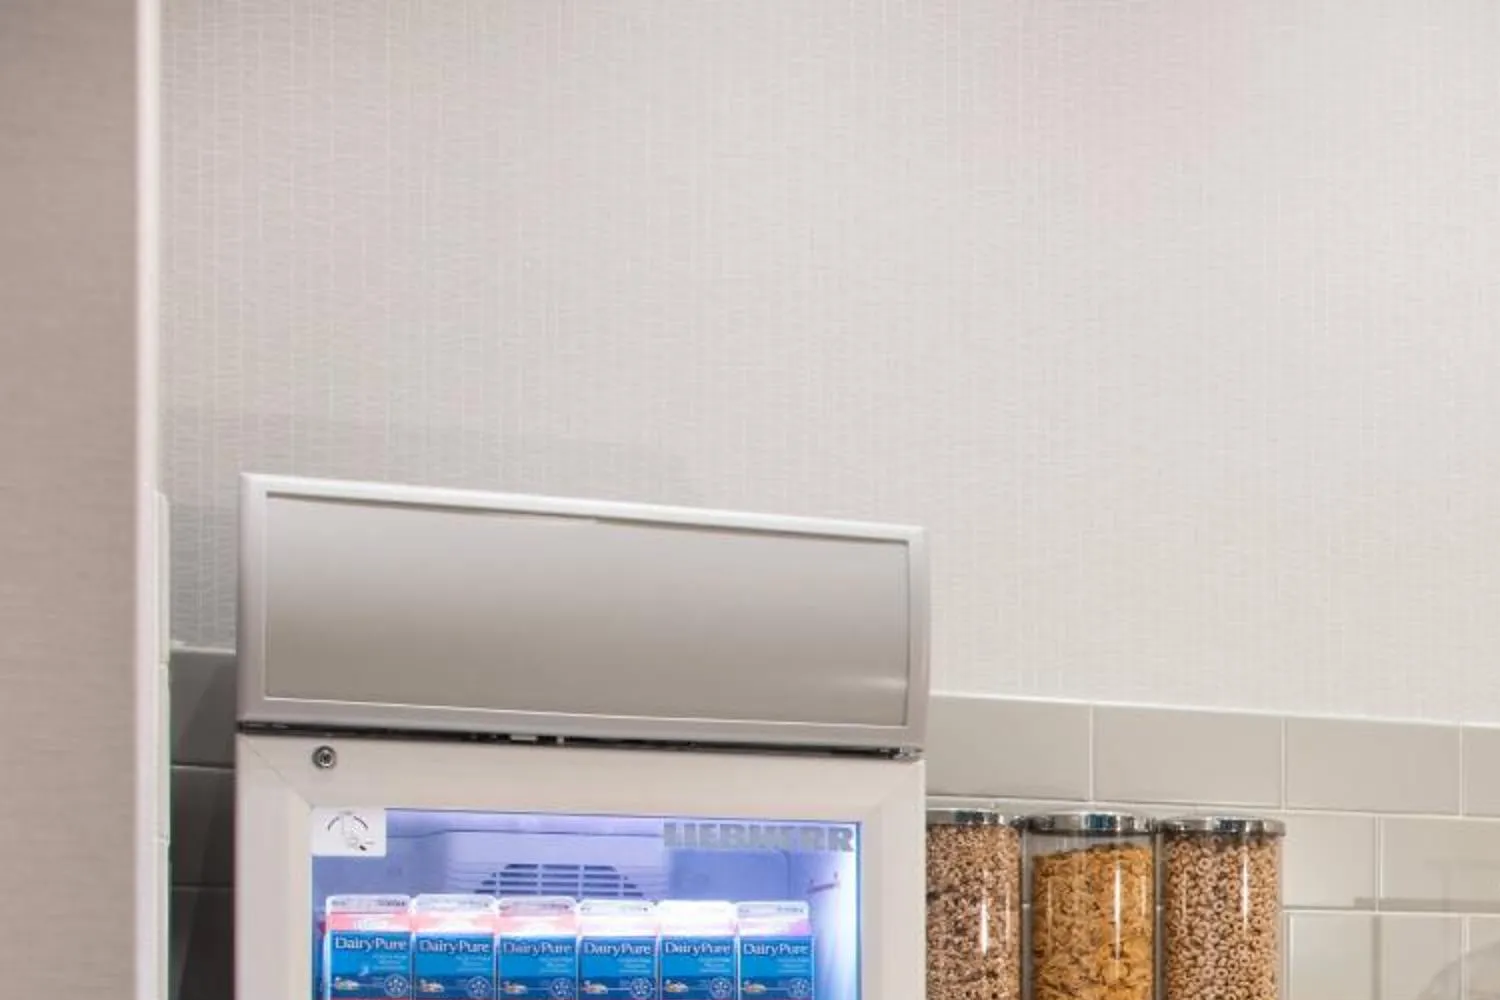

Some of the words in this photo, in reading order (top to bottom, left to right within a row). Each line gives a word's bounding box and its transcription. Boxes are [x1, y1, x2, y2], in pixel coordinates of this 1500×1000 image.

[335, 936, 407, 952] DairyPure
[419, 938, 491, 954] DairyPure
[503, 940, 574, 955] DairyPure
[584, 942, 651, 957] DairyPure
[665, 941, 731, 956] DairyPure
[743, 942, 809, 957] DairyPure
